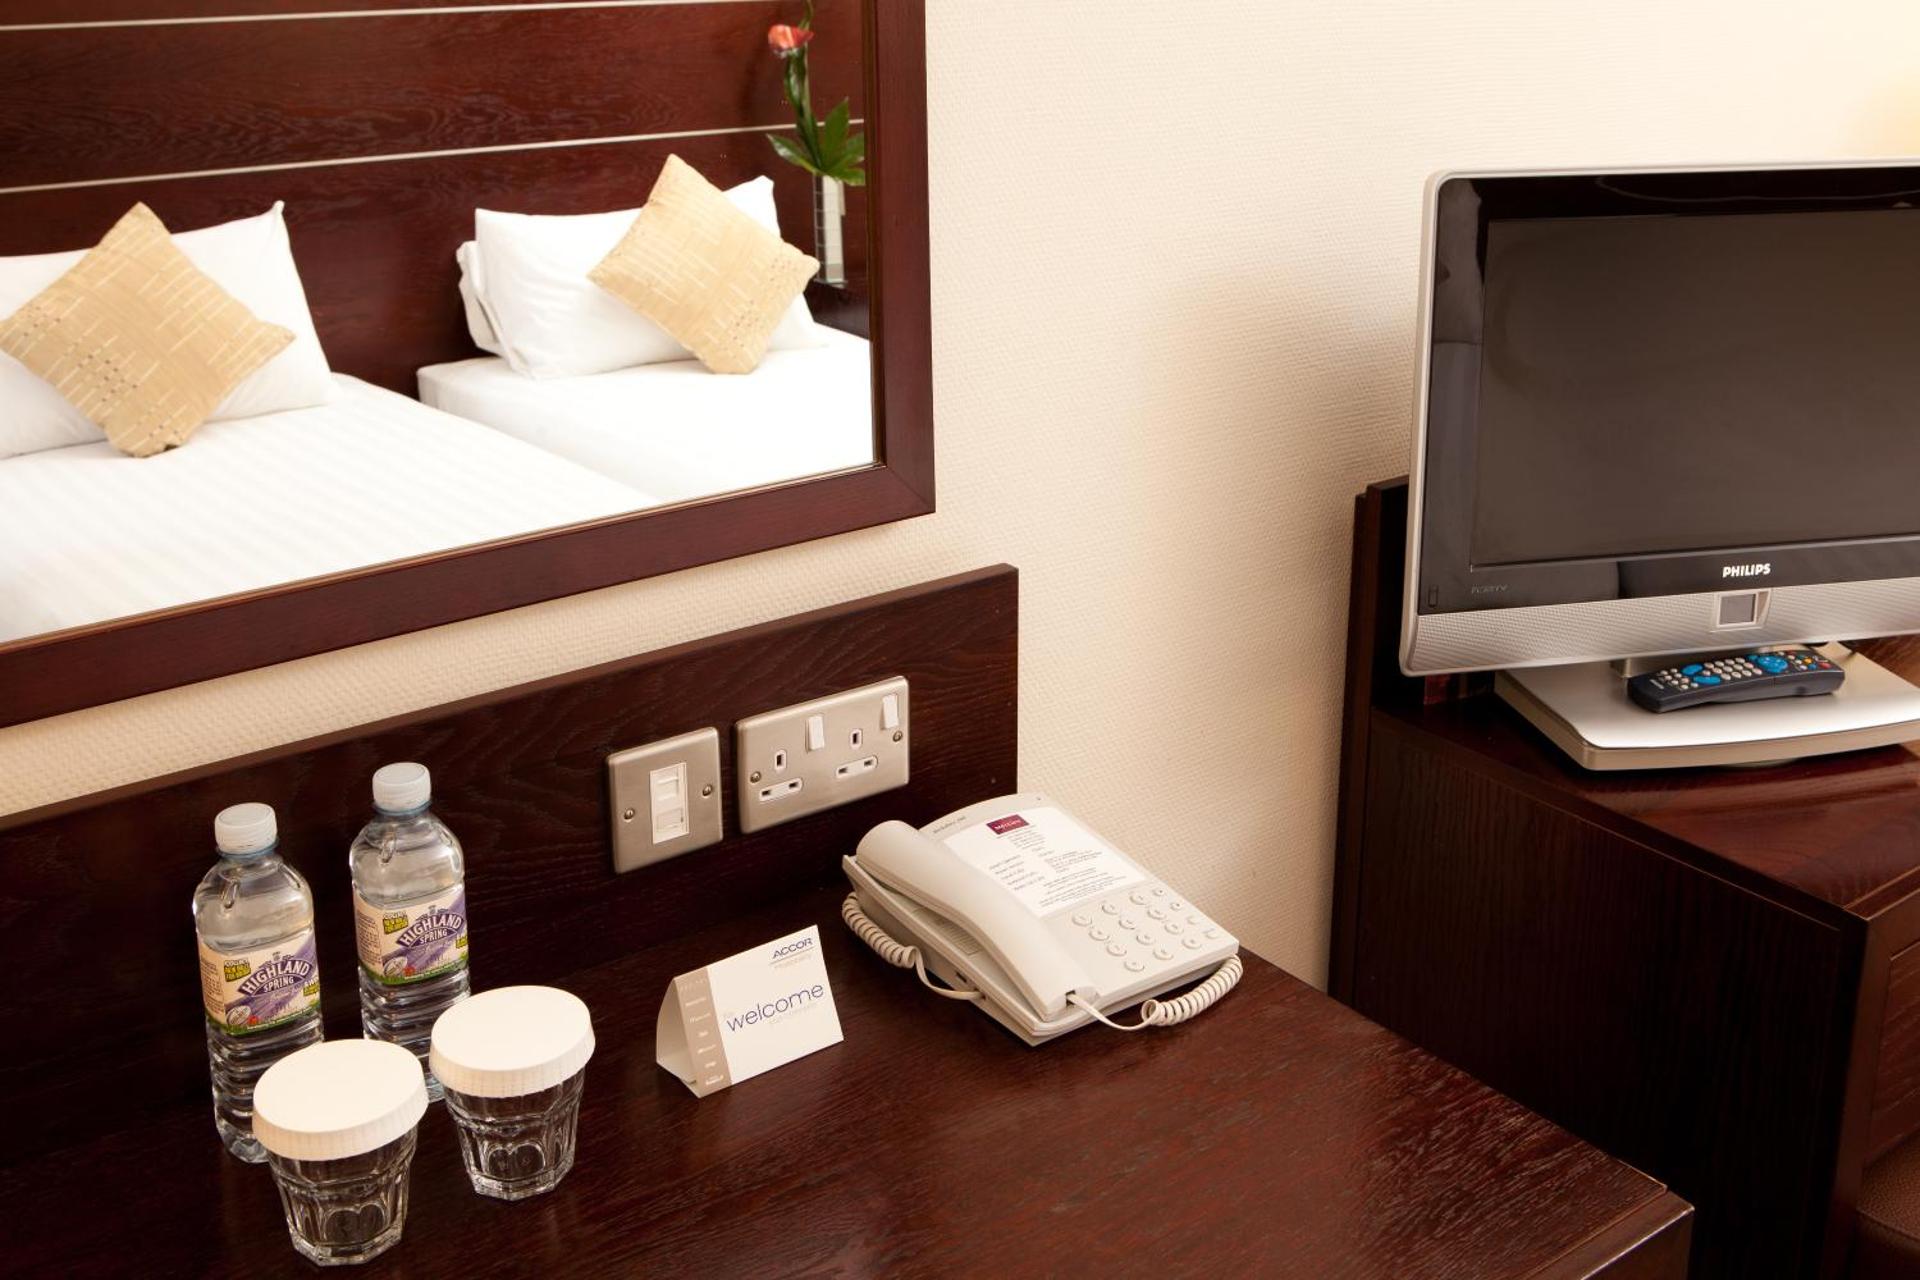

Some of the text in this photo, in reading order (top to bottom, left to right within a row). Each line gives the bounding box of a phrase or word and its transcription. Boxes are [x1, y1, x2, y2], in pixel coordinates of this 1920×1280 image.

[1722, 563, 1771, 578] PHILIPS
[400, 914, 463, 947] HIGHLAND
[419, 928, 449, 945] SPRING
[772, 937, 813, 960] ACCOR
[241, 961, 310, 994] HIGHLAND
[263, 976, 295, 993] SPRING
[726, 983, 825, 1032] welcome
